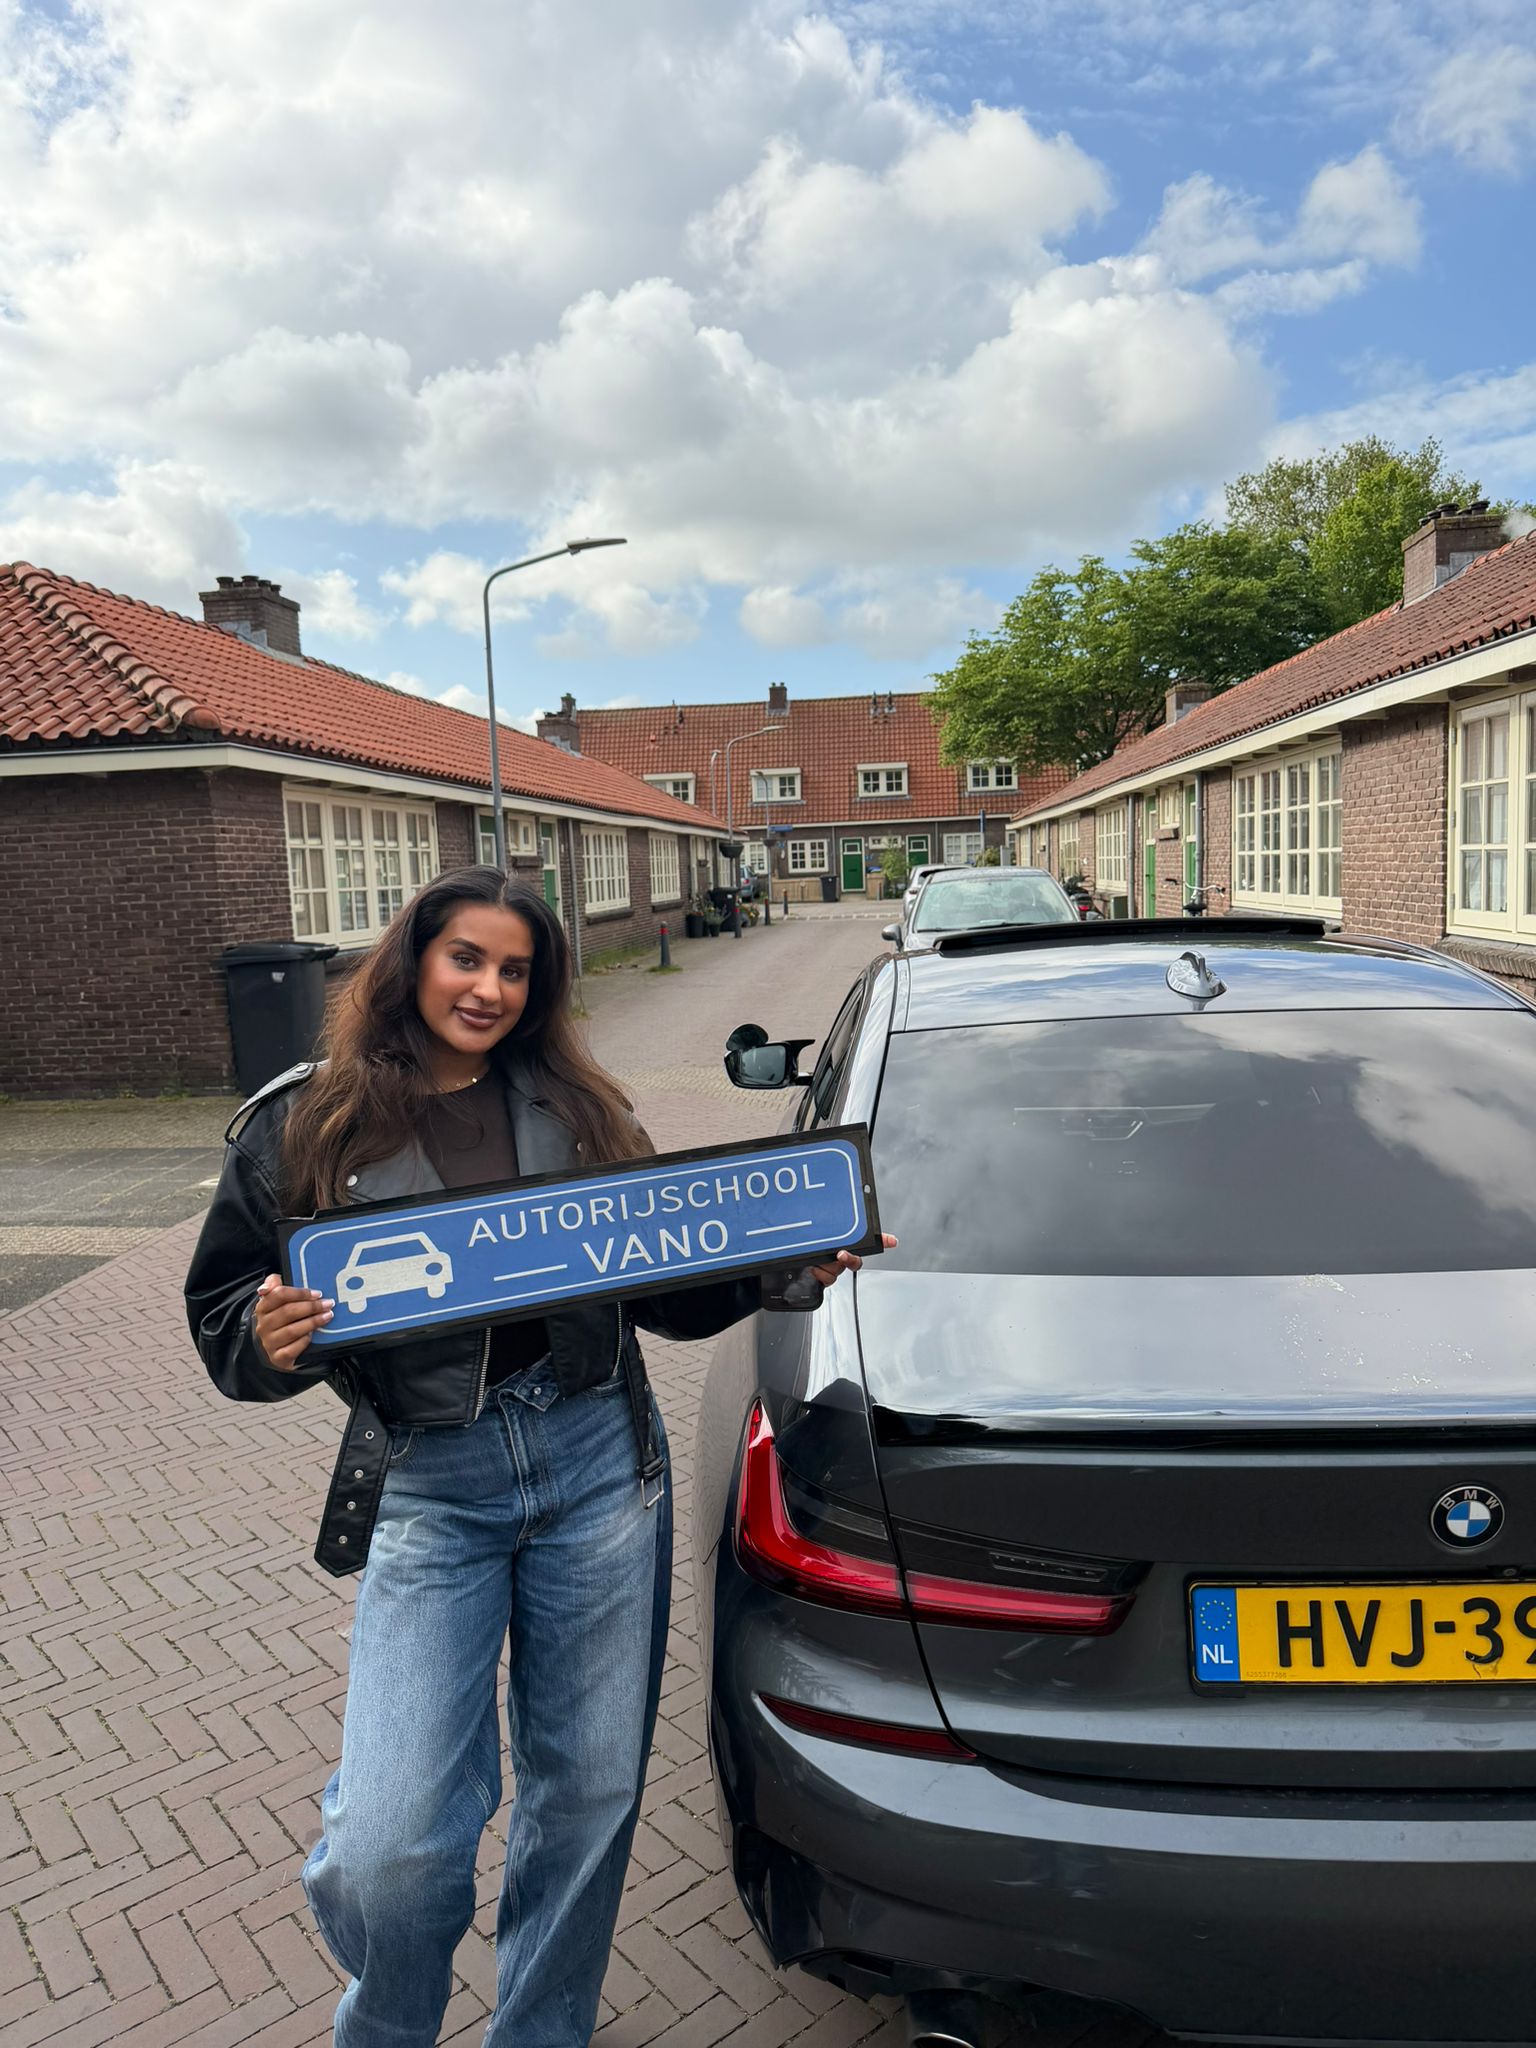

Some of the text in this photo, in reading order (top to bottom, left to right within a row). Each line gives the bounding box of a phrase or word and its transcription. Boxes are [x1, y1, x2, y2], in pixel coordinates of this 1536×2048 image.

[468, 1163, 826, 1248] AUTORIJSCHOOL
[582, 1219, 729, 1274] VANO
[1440, 1489, 1501, 1511] BMW
[1202, 1644, 1233, 1664] NL
